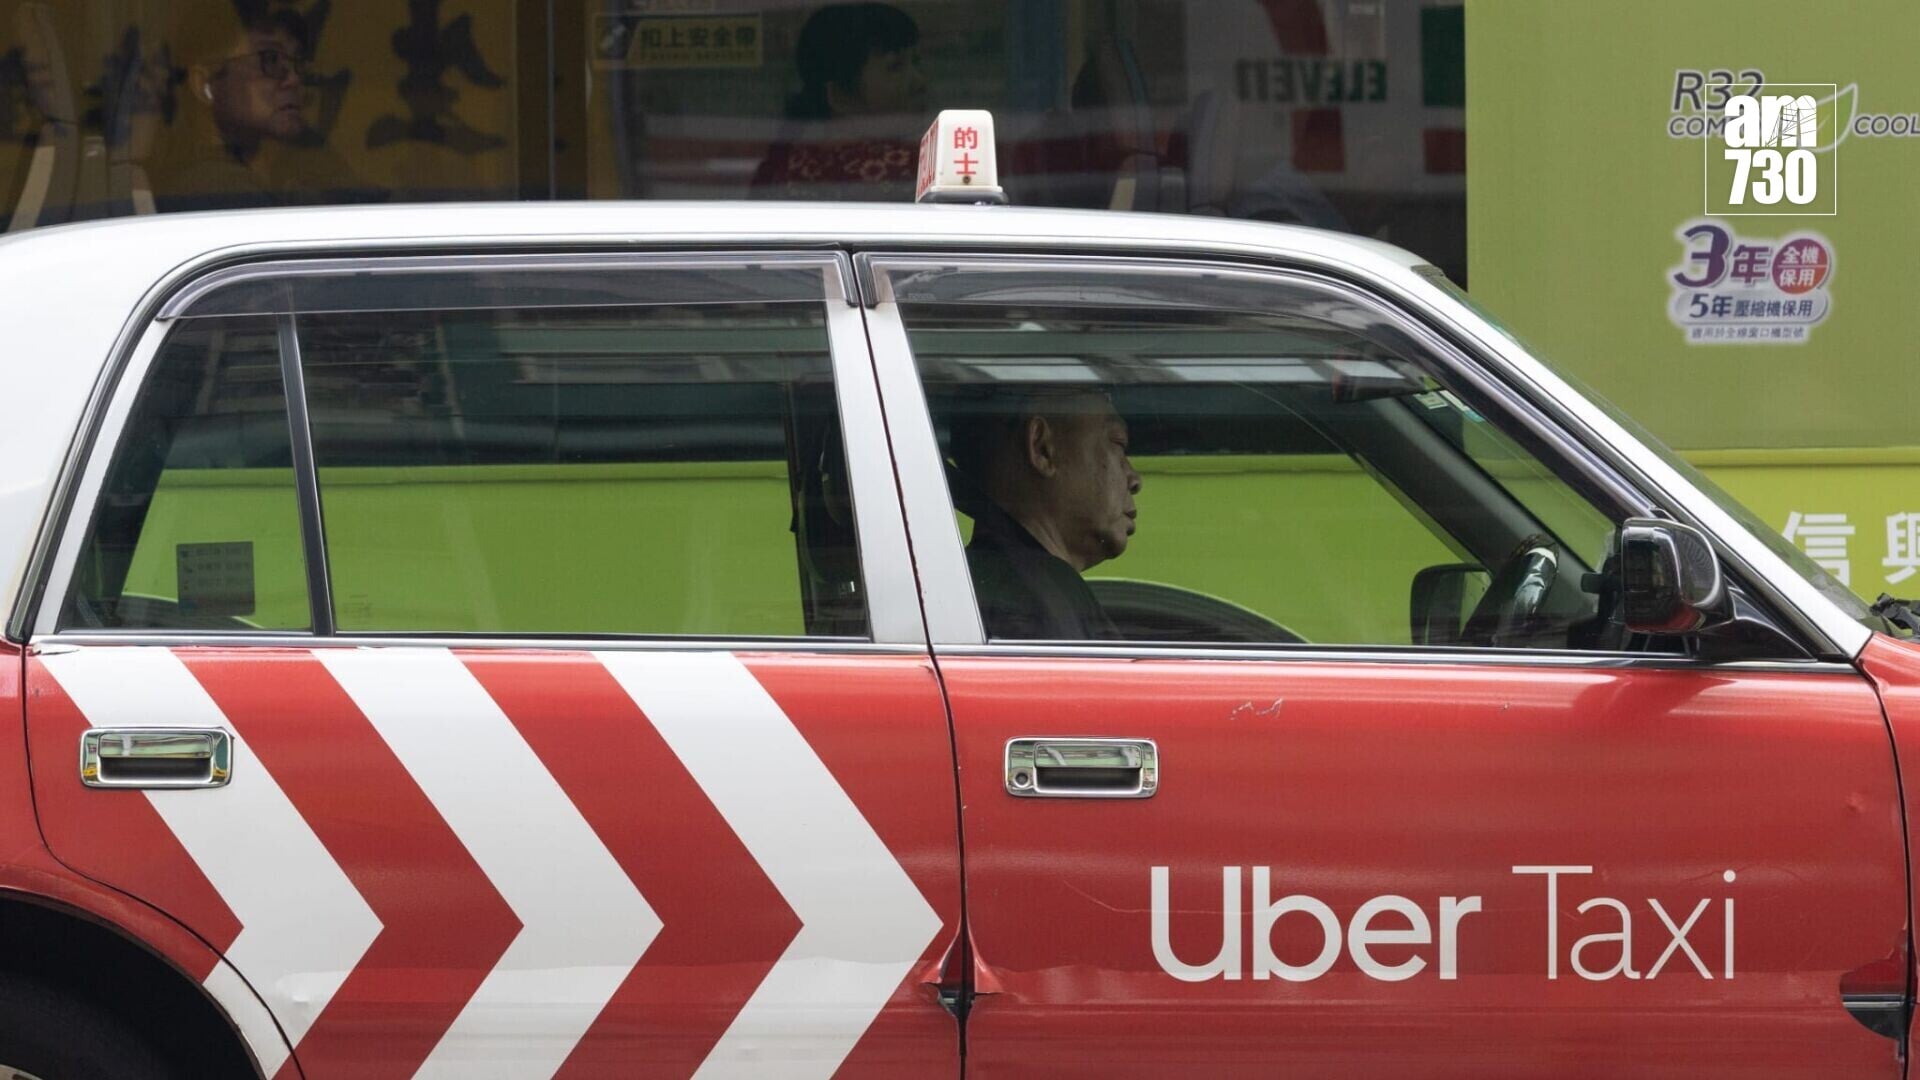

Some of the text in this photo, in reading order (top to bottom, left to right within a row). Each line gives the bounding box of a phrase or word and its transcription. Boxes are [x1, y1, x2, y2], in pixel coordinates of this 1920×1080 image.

[953, 126, 979, 176] 的士
[1674, 224, 1769, 288] 3年
[1779, 268, 1815, 287] 保用
[1782, 246, 1820, 265] 全機
[1150, 865, 1736, 982] Uber Taxi
